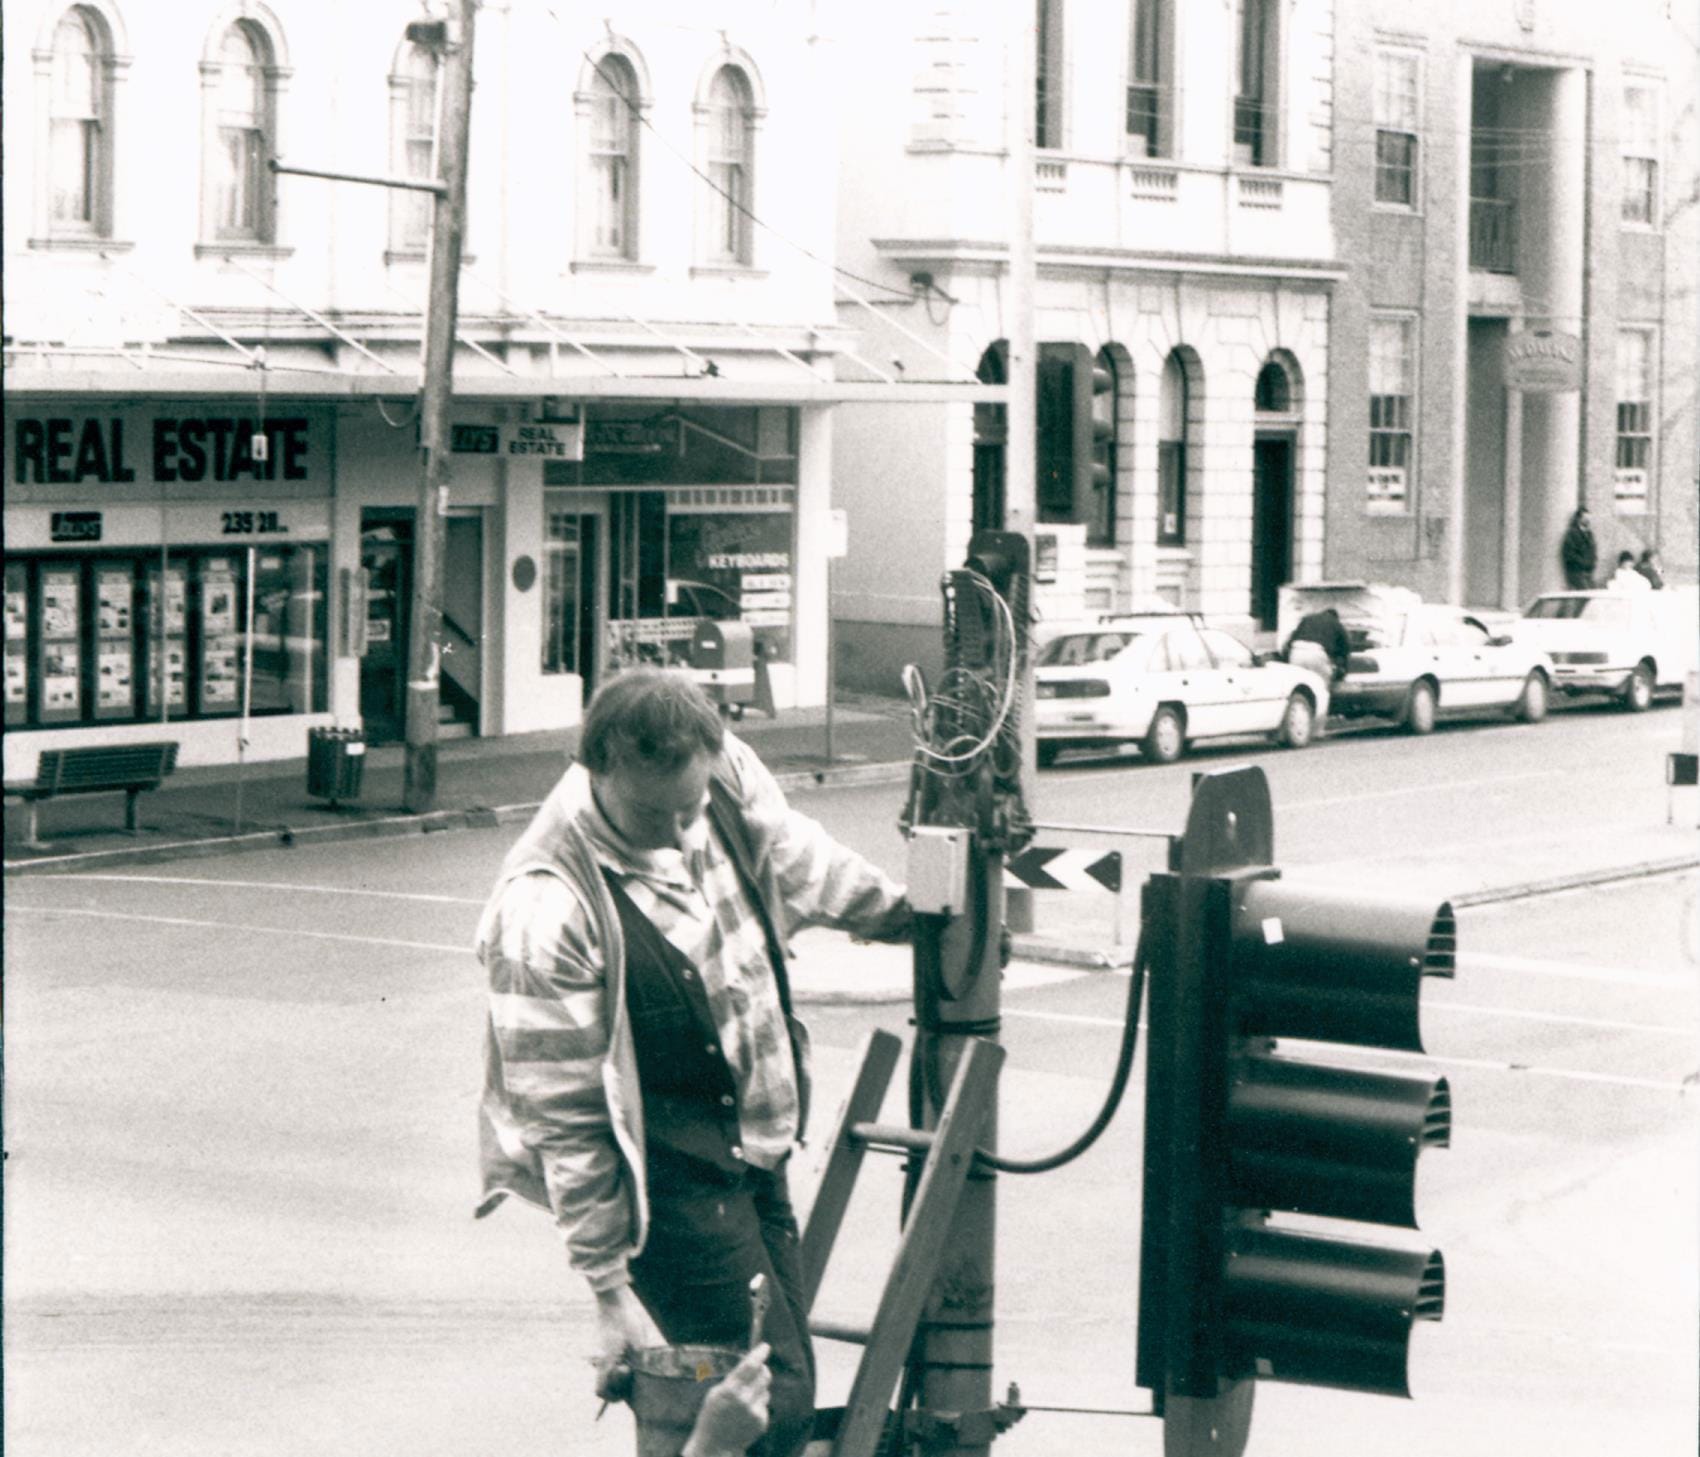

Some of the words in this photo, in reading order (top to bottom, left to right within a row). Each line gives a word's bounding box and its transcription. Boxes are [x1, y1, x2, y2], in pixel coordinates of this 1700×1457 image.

[518, 426, 557, 441] REAL
[15, 418, 135, 483] REAL
[152, 417, 308, 481] ESTATE
[508, 440, 566, 456] ESTATE
[708, 552, 789, 568] KEYBOARDS
